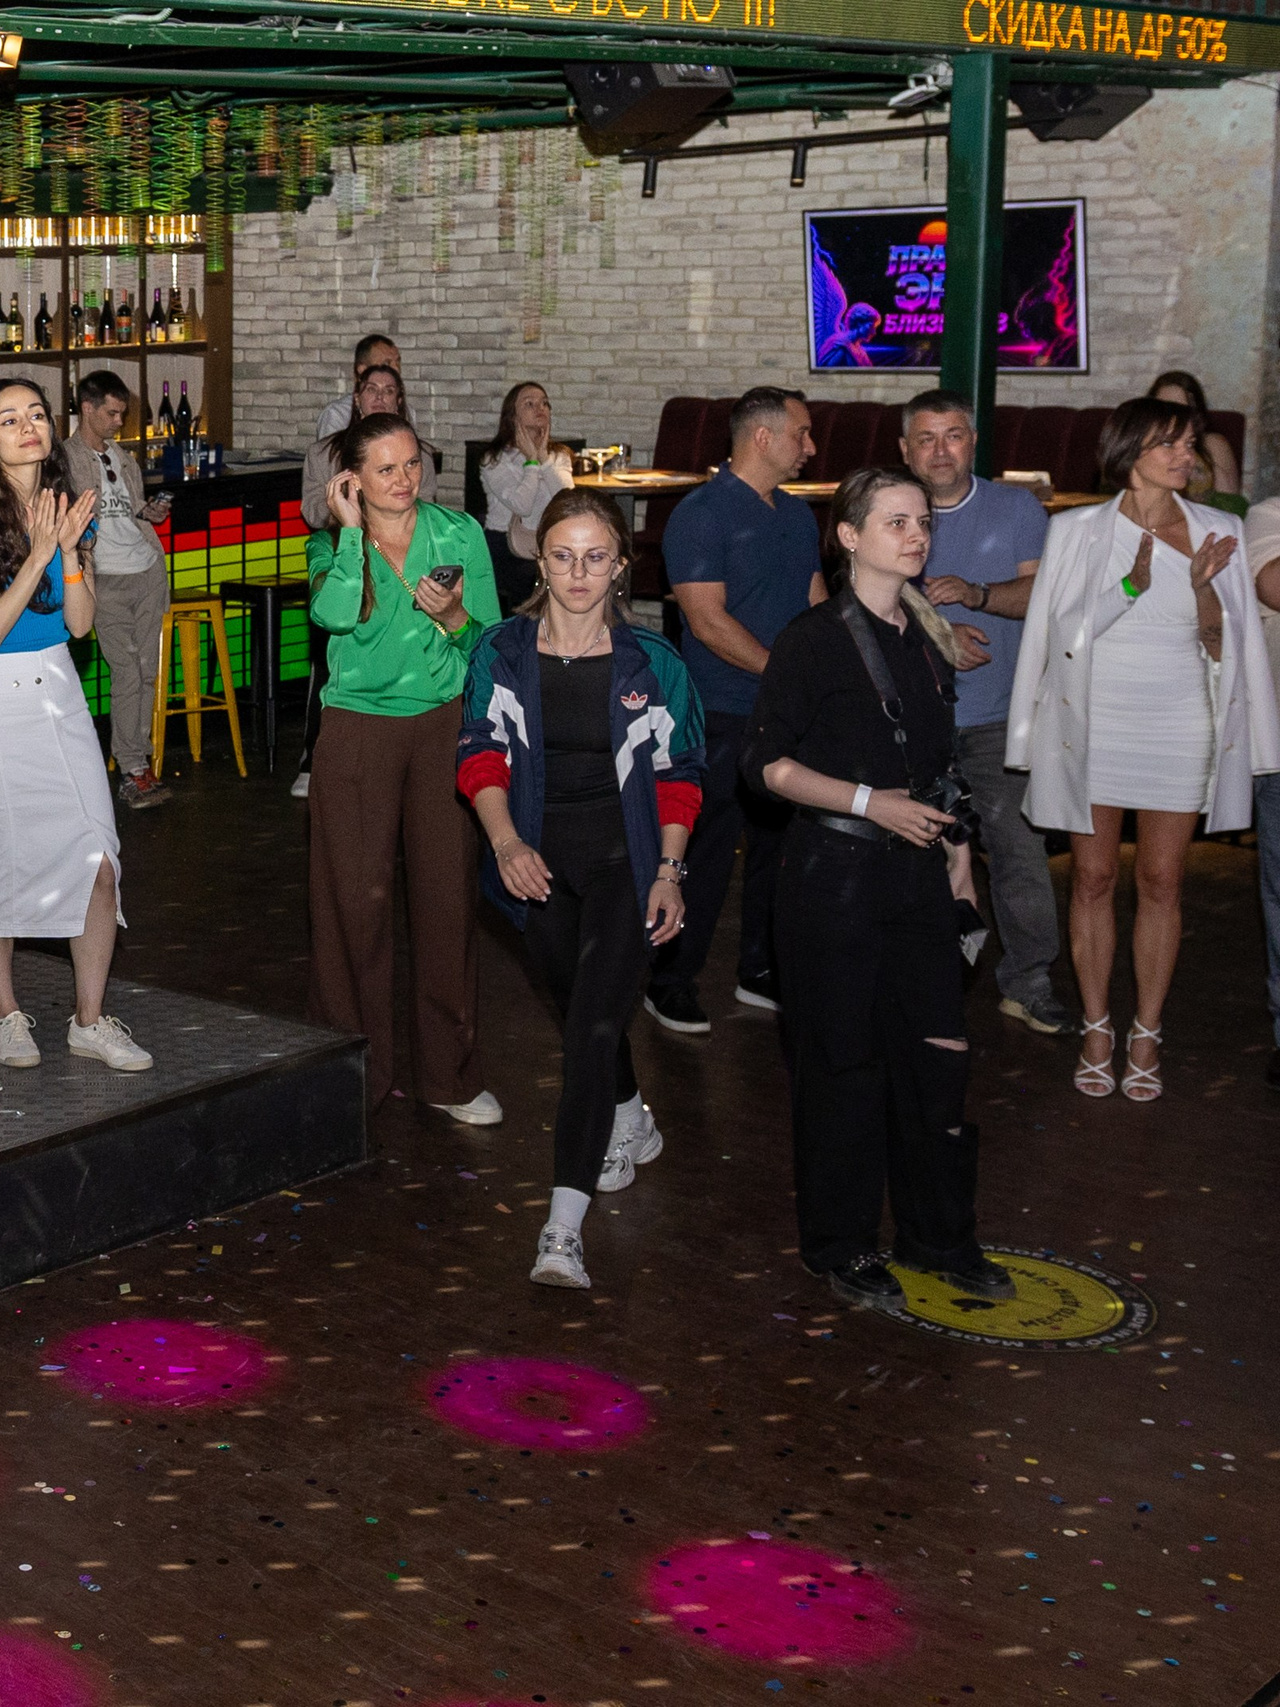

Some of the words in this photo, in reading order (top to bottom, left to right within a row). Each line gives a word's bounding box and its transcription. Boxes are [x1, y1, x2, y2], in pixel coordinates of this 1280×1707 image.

[963, 0, 1086, 52] СКИДКА
[1093, 8, 1132, 54] НА
[1134, 13, 1174, 61] ДР
[1176, 16, 1228, 62] 50%
